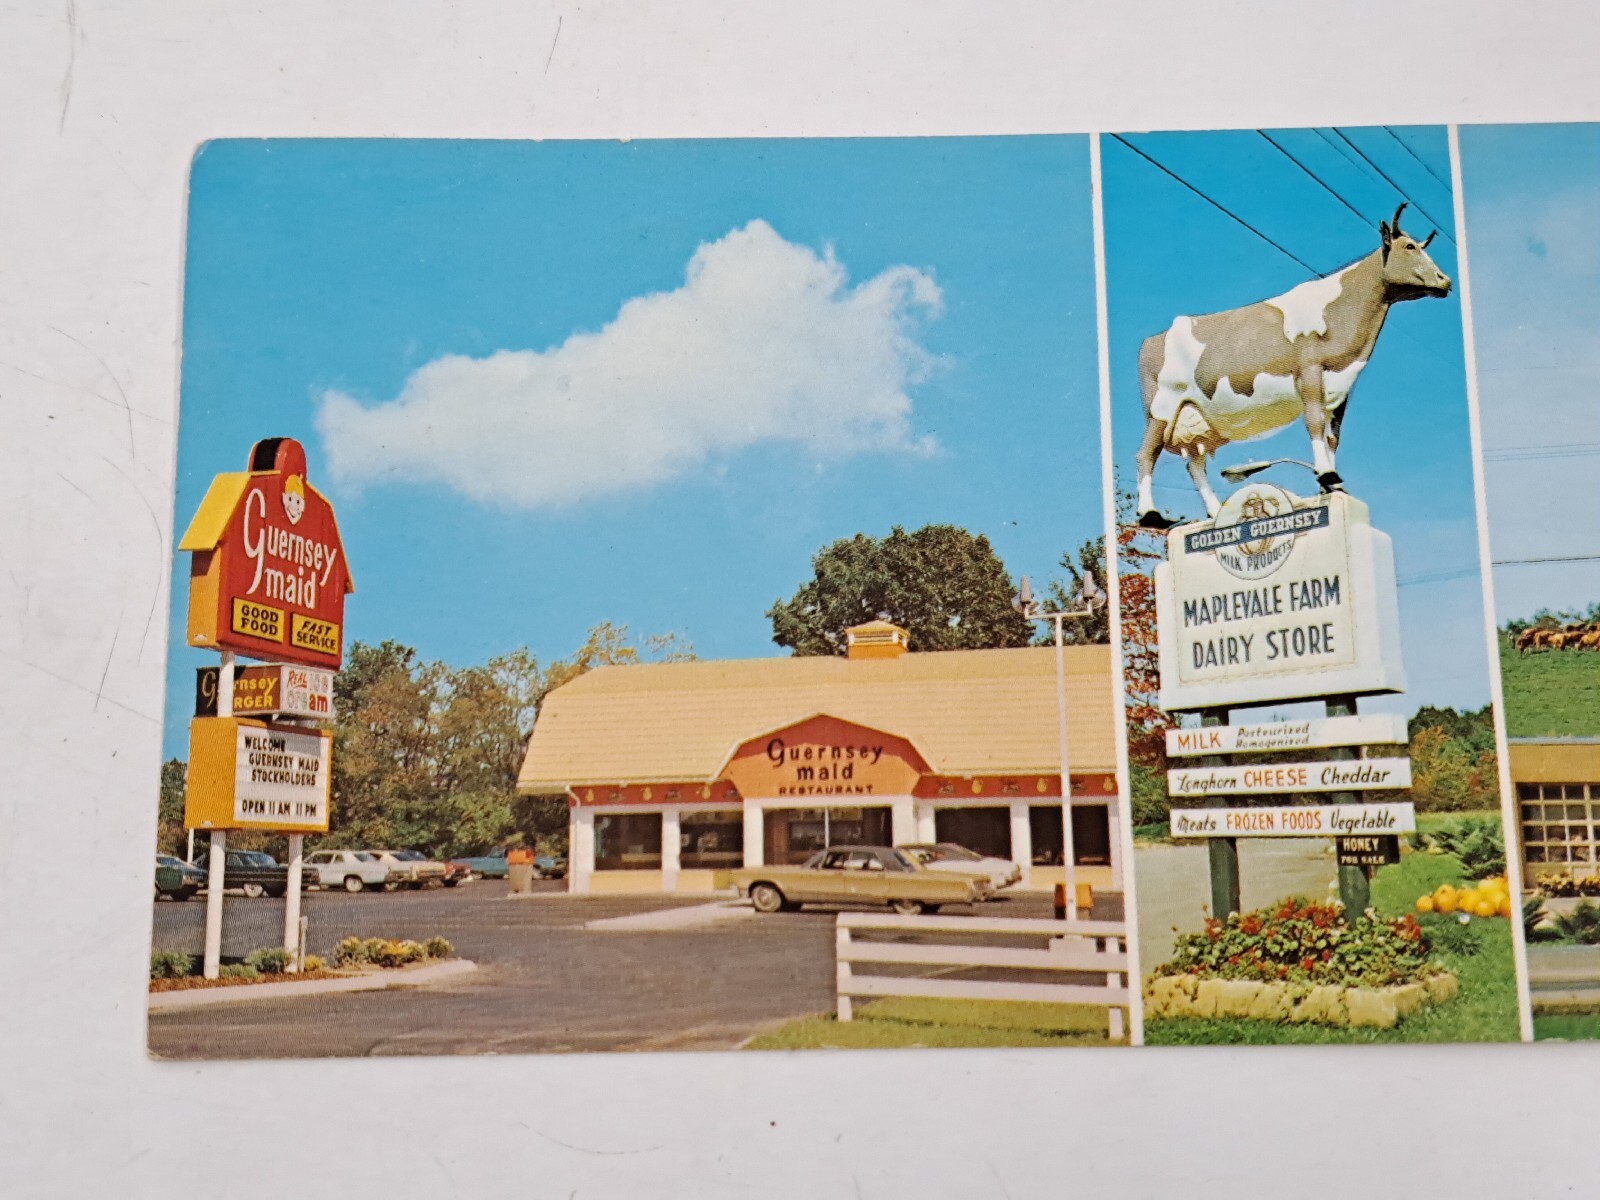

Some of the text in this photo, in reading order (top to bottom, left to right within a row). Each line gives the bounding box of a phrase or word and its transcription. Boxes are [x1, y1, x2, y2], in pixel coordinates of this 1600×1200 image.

[1191, 510, 1322, 549] GOLDEN GUERNSEY
[243, 488, 337, 595] Guernsey
[1220, 539, 1293, 571] MILK PRODUCTS
[264, 566, 316, 609] maid
[1184, 575, 1342, 628] MAPLEVALE FARM
[241, 604, 279, 623] GOOD
[240, 617, 278, 636] FOOD
[301, 620, 332, 636] FAST
[296, 630, 337, 650] SERVICE
[1193, 622, 1335, 670] DAIRY STORE
[201, 670, 278, 709] Grnsey
[244, 735, 286, 752] WELCOME
[1177, 731, 1222, 751] MILK
[248, 752, 320, 772] GUERNSEY MAID
[767, 738, 883, 769] Guernsey
[251, 768, 316, 787] STOCKHOLDERS
[1178, 765, 1391, 793] Longhorn CHEESE Cheddar
[778, 784, 873, 796] RESTAURANT
[242, 799, 266, 814] OPEN
[277, 801, 291, 816] AM
[305, 803, 317, 817] PM
[1177, 808, 1396, 834] Meats FROZEN FOODS Vegetable
[1342, 837, 1380, 852] HONEY
[1341, 855, 1359, 865] FOR
